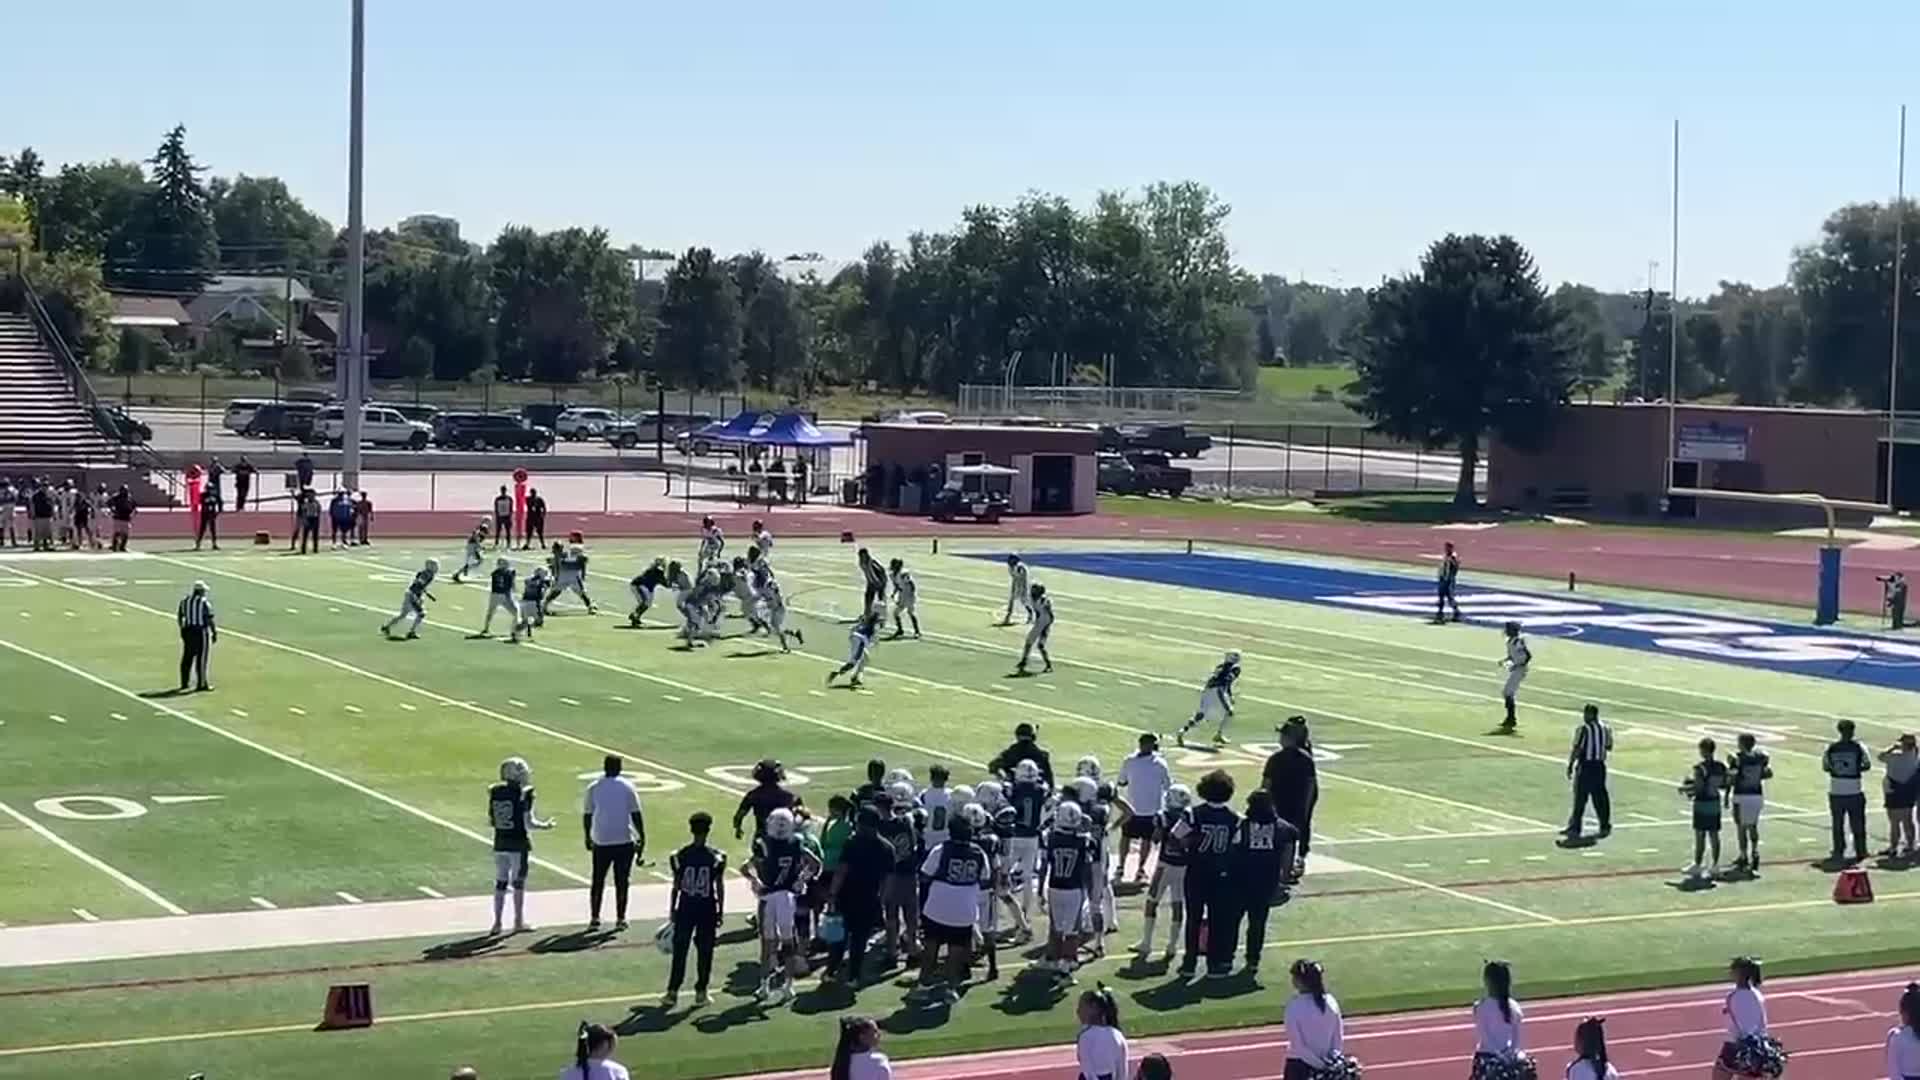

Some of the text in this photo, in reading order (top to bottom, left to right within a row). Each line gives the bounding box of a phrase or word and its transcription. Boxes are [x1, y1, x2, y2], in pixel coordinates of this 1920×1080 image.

[1198, 824, 1230, 853] 70
[774, 855, 793, 885] 7
[1054, 848, 1079, 878] 17
[681, 865, 711, 897] 44
